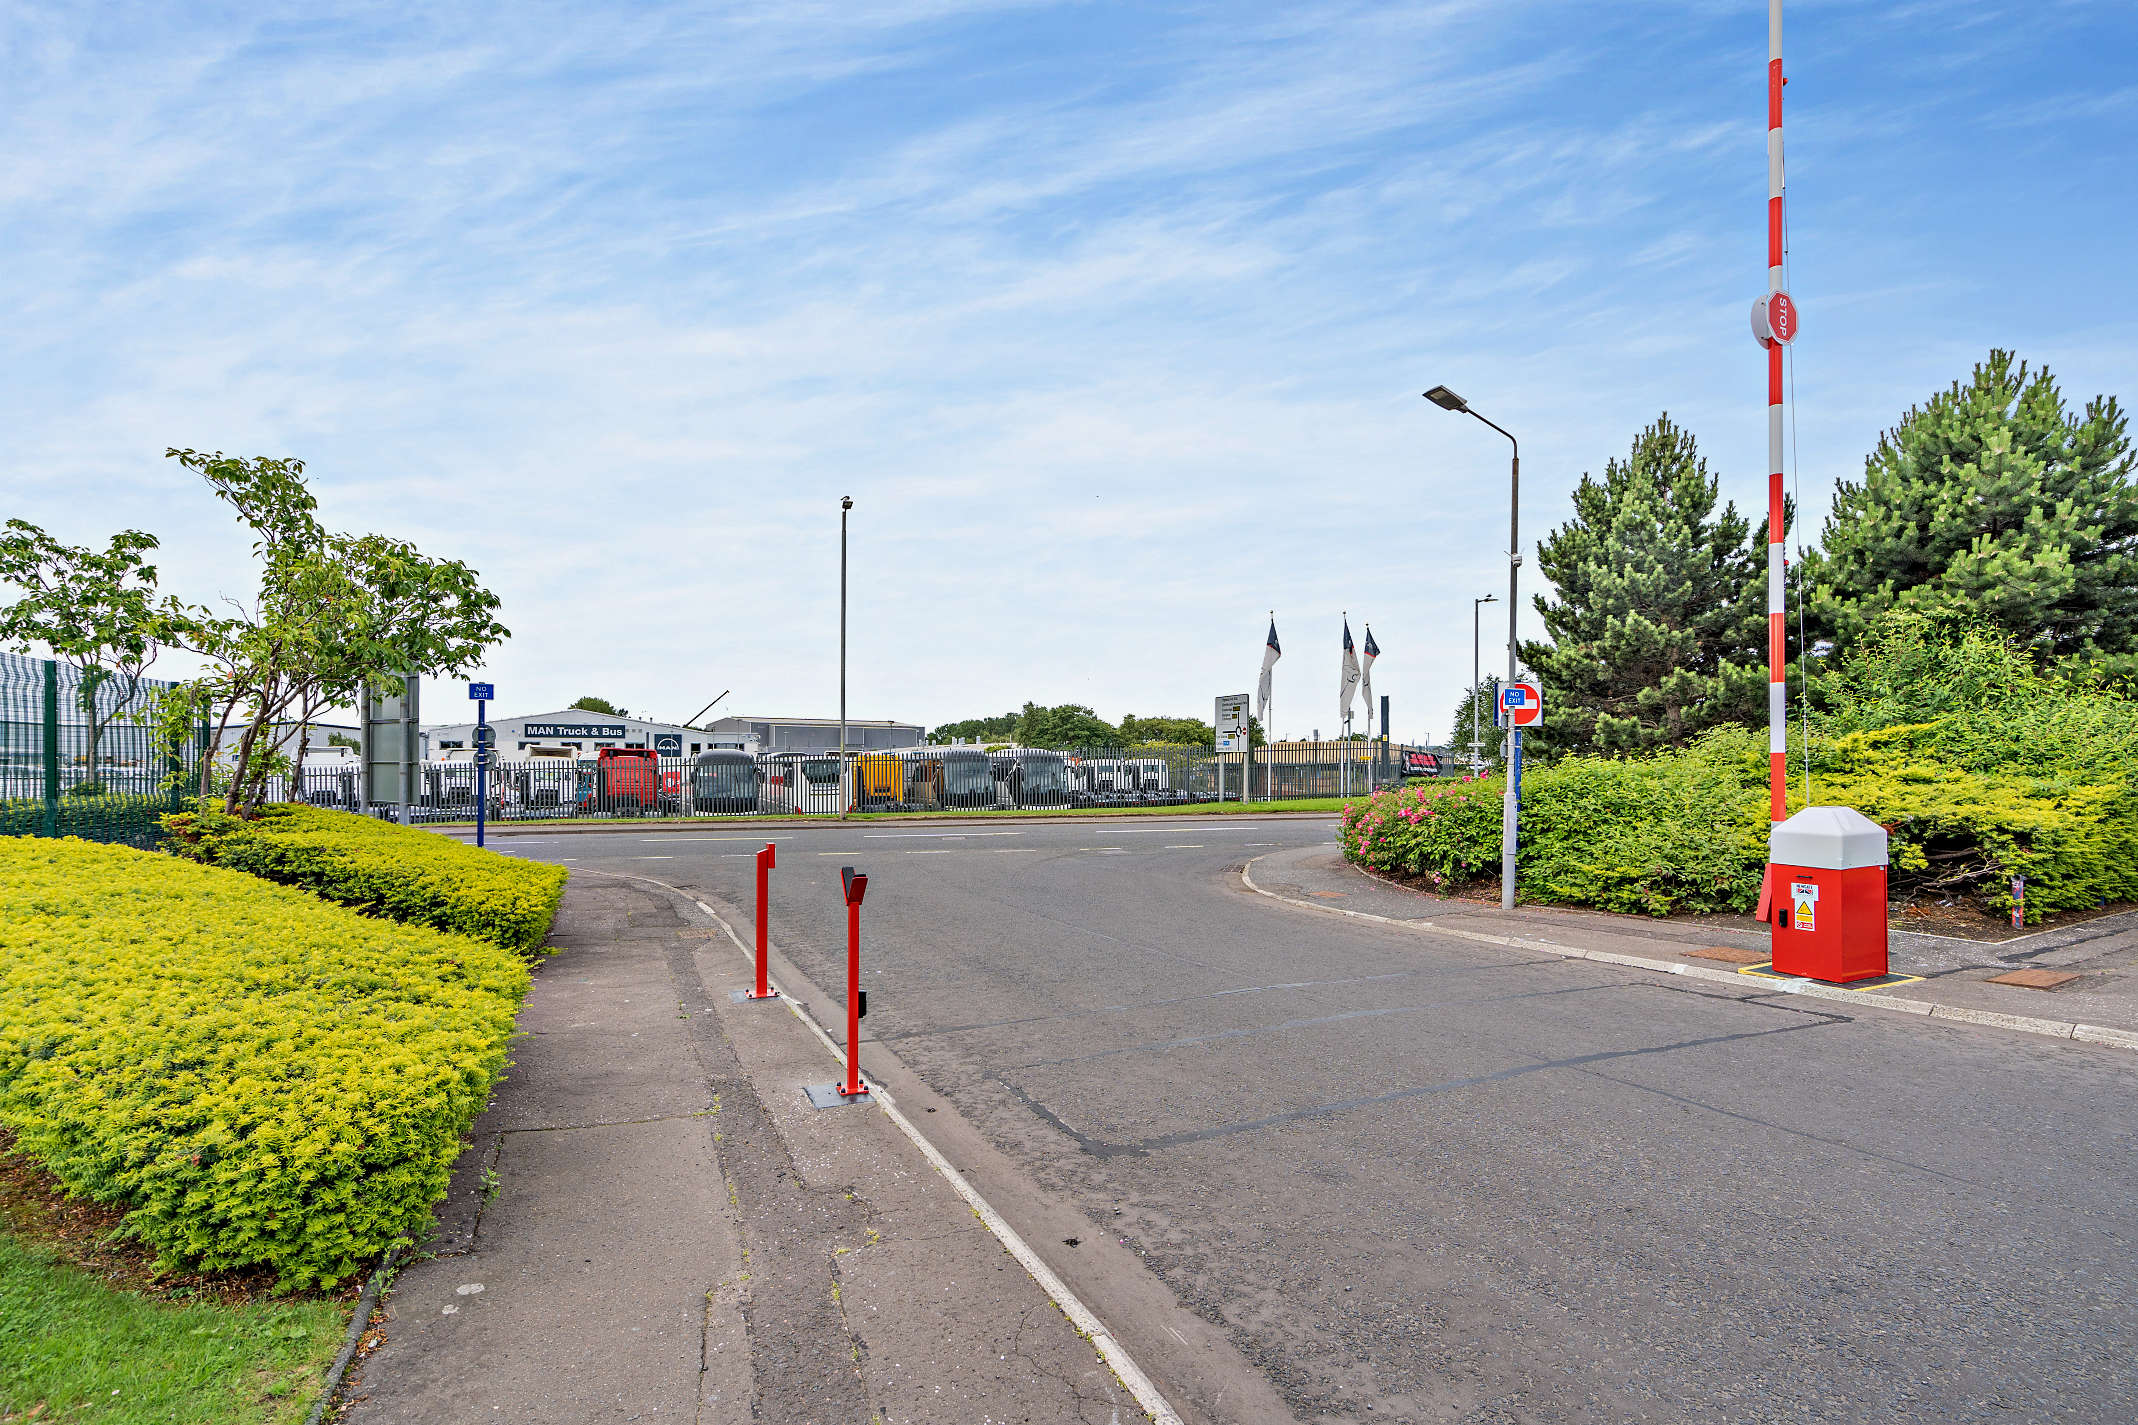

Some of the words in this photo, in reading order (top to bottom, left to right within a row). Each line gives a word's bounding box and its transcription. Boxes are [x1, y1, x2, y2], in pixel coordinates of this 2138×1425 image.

[527, 726, 554, 735] MAN
[557, 726, 588, 736] Truck
[591, 727, 600, 736] &
[602, 727, 623, 736] Bus
